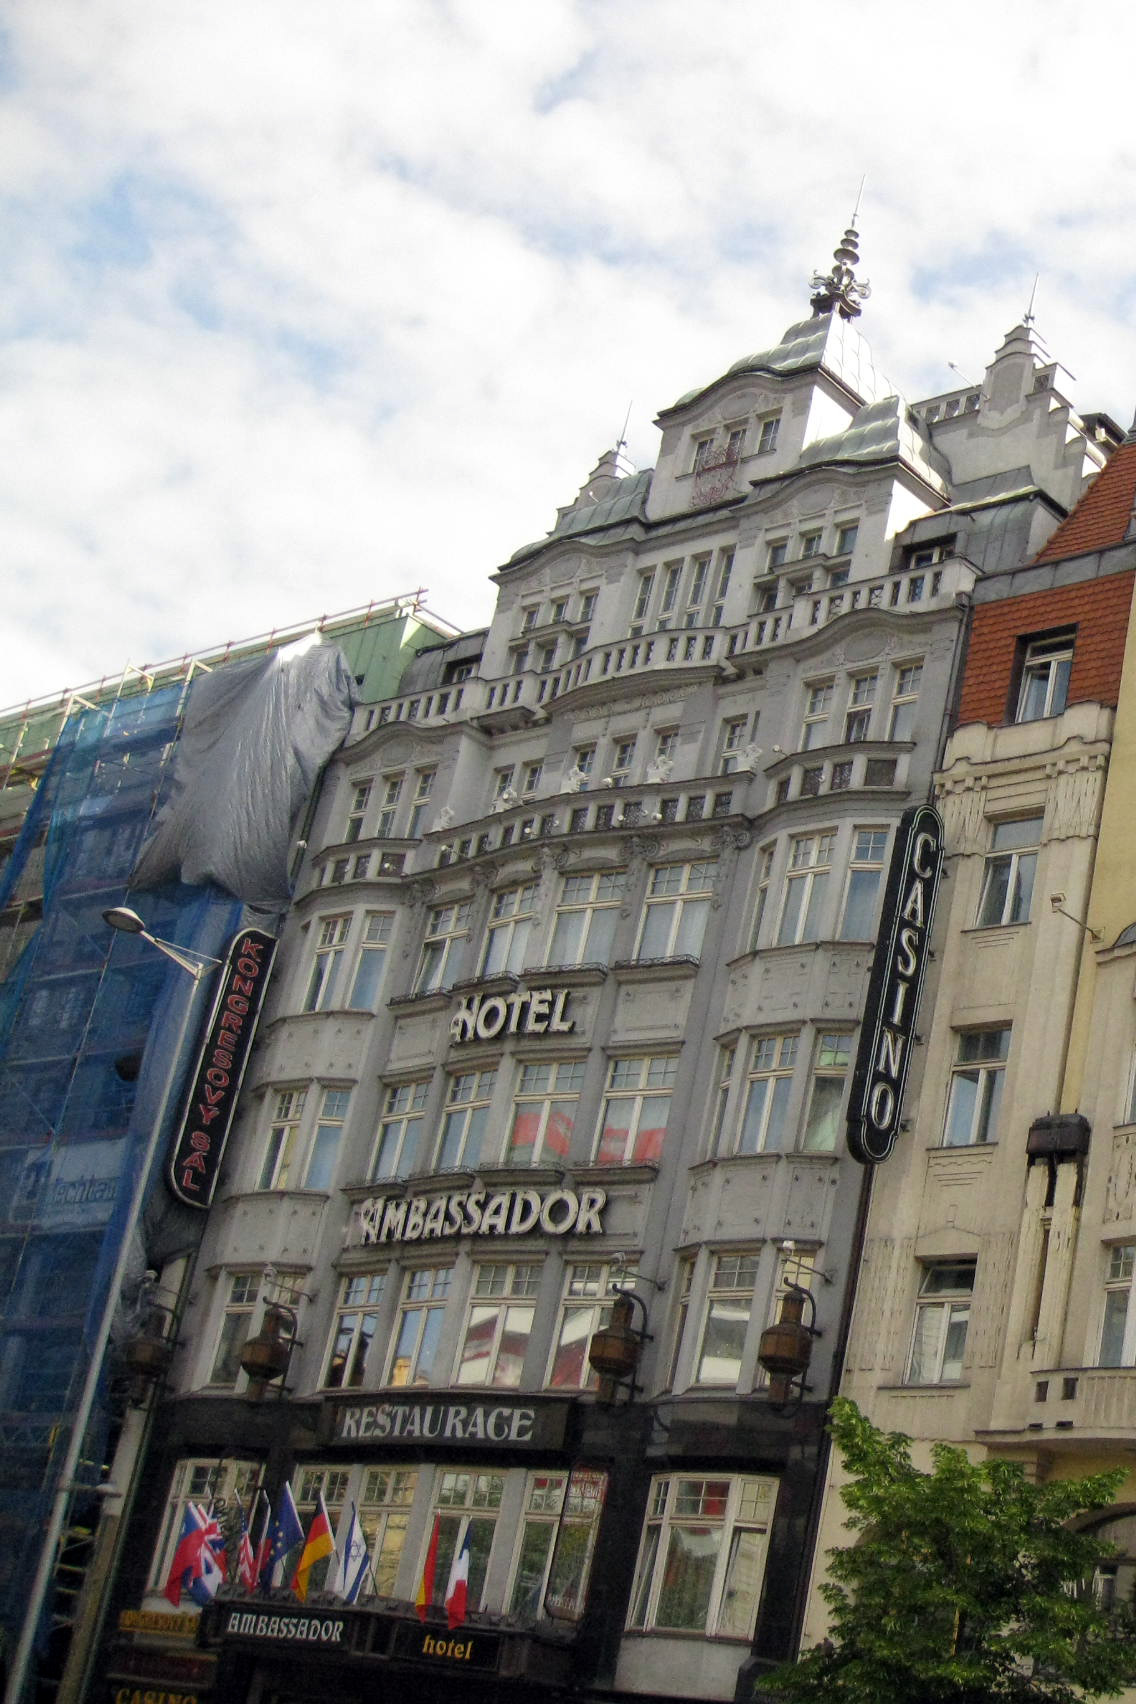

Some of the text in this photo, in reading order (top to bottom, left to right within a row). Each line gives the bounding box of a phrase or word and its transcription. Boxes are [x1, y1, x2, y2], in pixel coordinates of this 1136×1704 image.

[868, 831, 937, 1131] CASINO
[450, 989, 574, 1044] HOTEL
[359, 1187, 608, 1246] AMBASSADOR
[341, 1405, 535, 1441] RESTAURACE
[226, 1612, 344, 1643] AMBASSADOR
[422, 1634, 474, 1661] hotel
